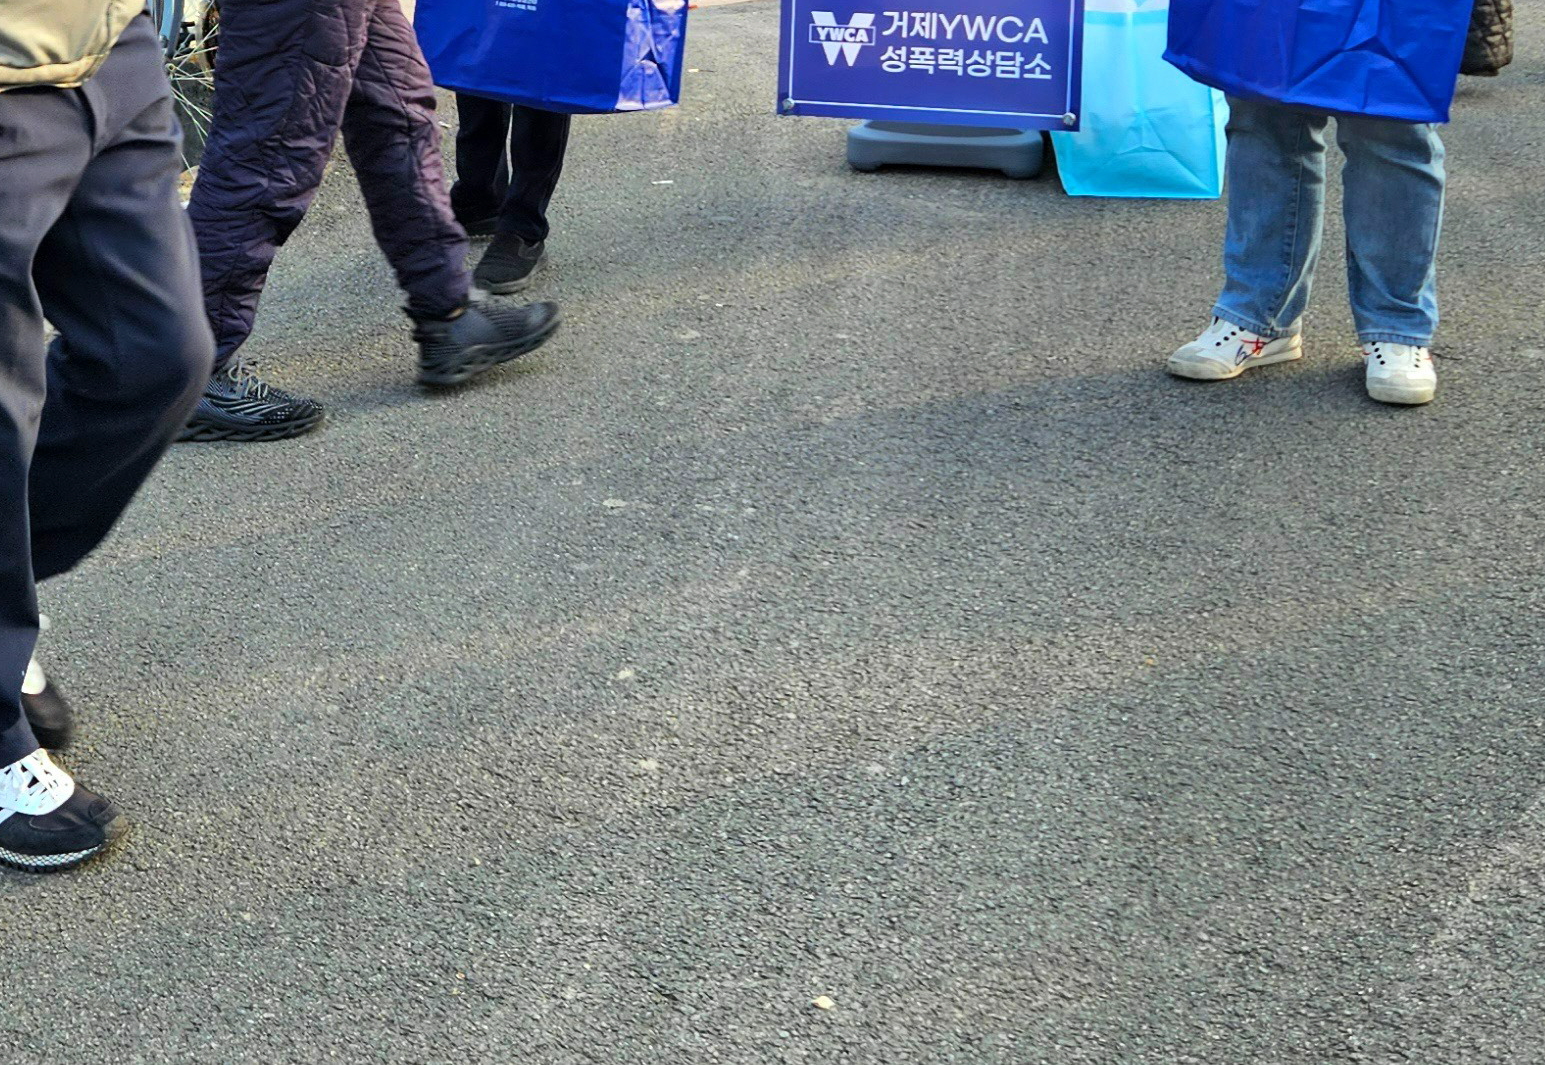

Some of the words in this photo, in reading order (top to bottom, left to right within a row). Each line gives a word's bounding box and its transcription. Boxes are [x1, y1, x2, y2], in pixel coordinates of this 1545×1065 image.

[816, 27, 869, 43] YWCA
[882, 10, 1049, 45] 거제YWCA
[880, 45, 1053, 80] 성폭력상담소
